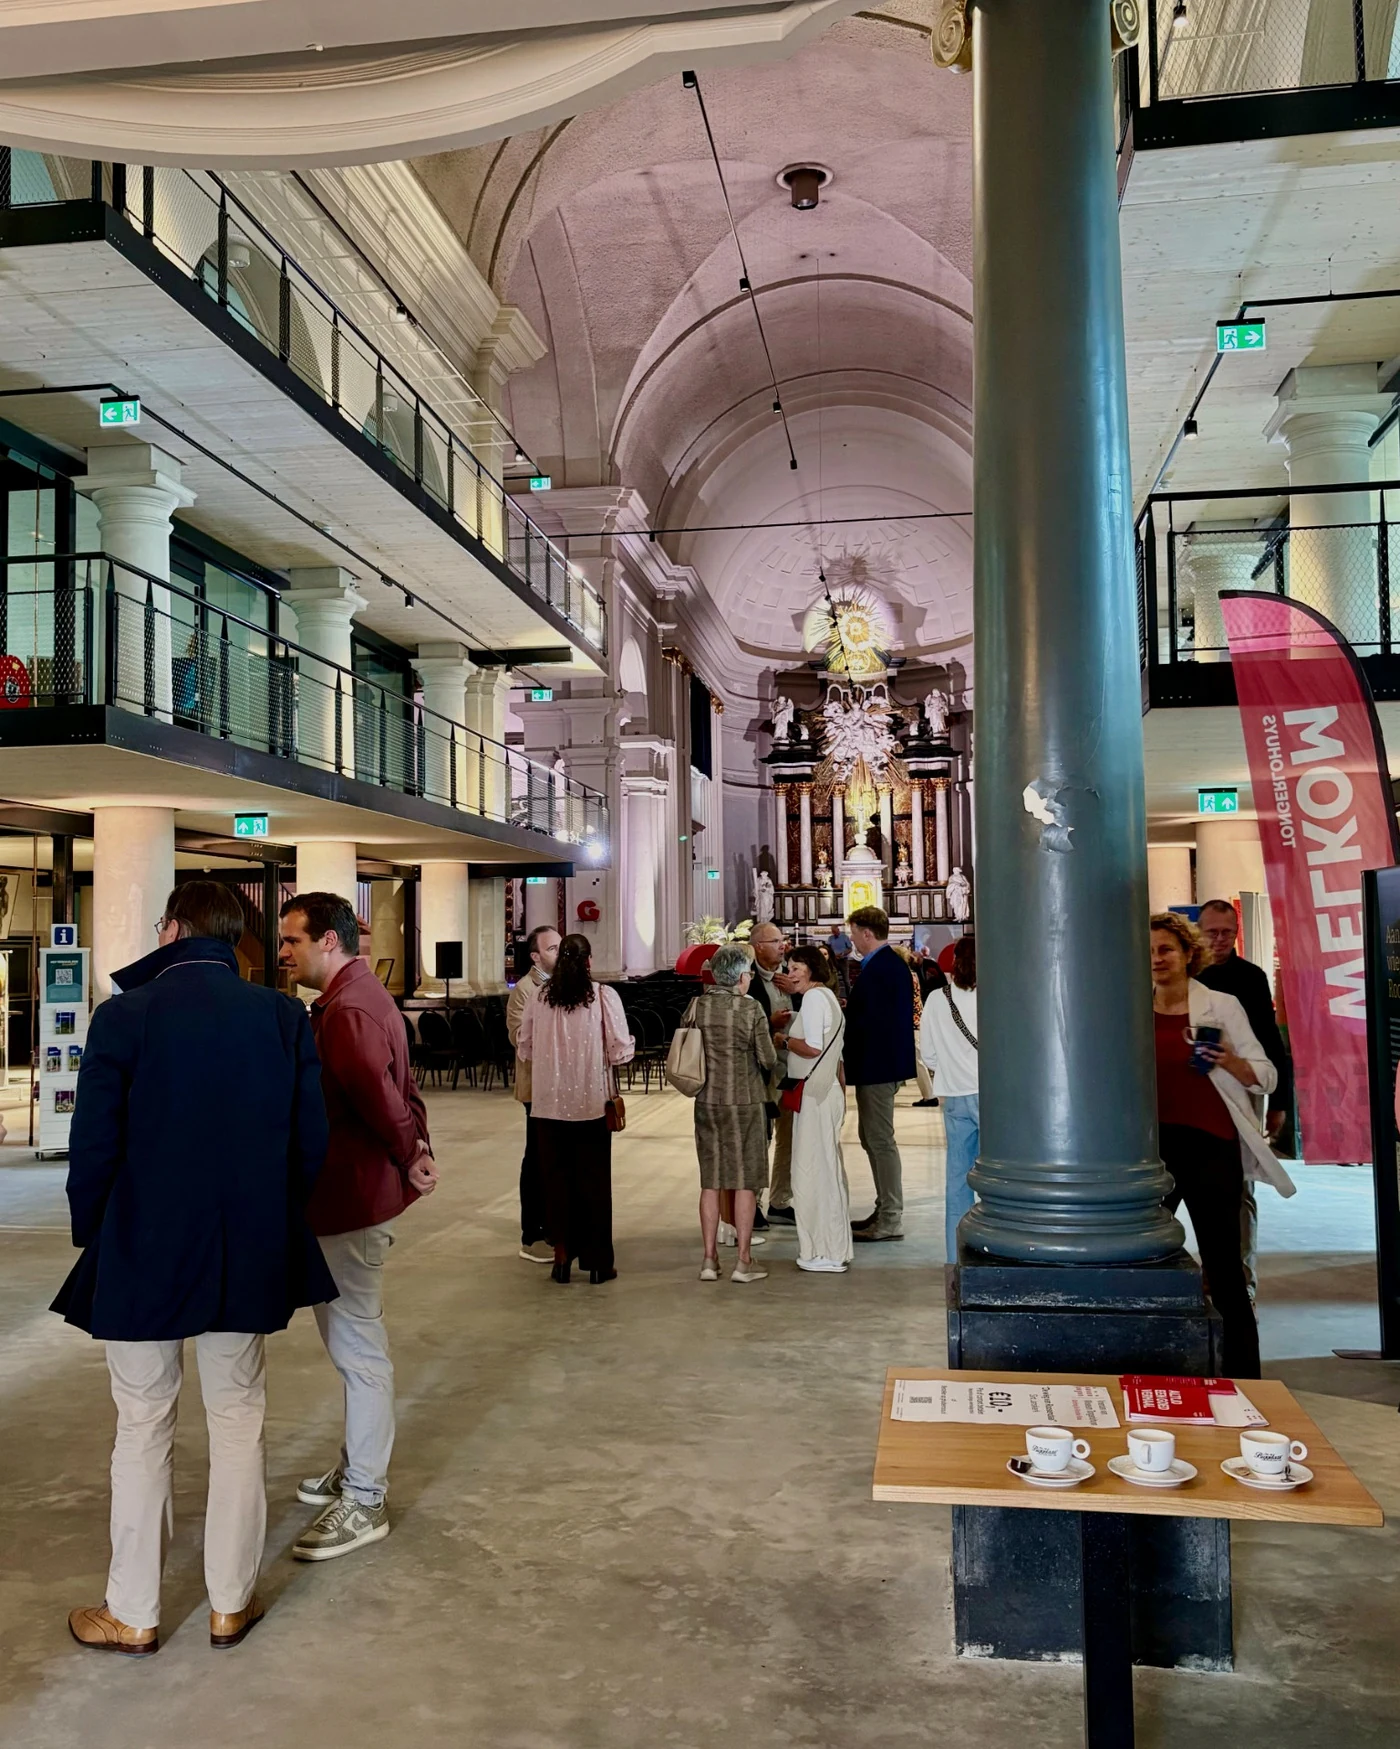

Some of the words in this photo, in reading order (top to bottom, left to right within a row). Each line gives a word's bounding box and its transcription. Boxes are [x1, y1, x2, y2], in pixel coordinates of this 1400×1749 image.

[1386, 950, 1400, 971] wie
[985, 1391, 1012, 1412] €10,-
[1141, 1389, 1155, 1408] VERHAAL
[1157, 1398, 1170, 1410] GOED
